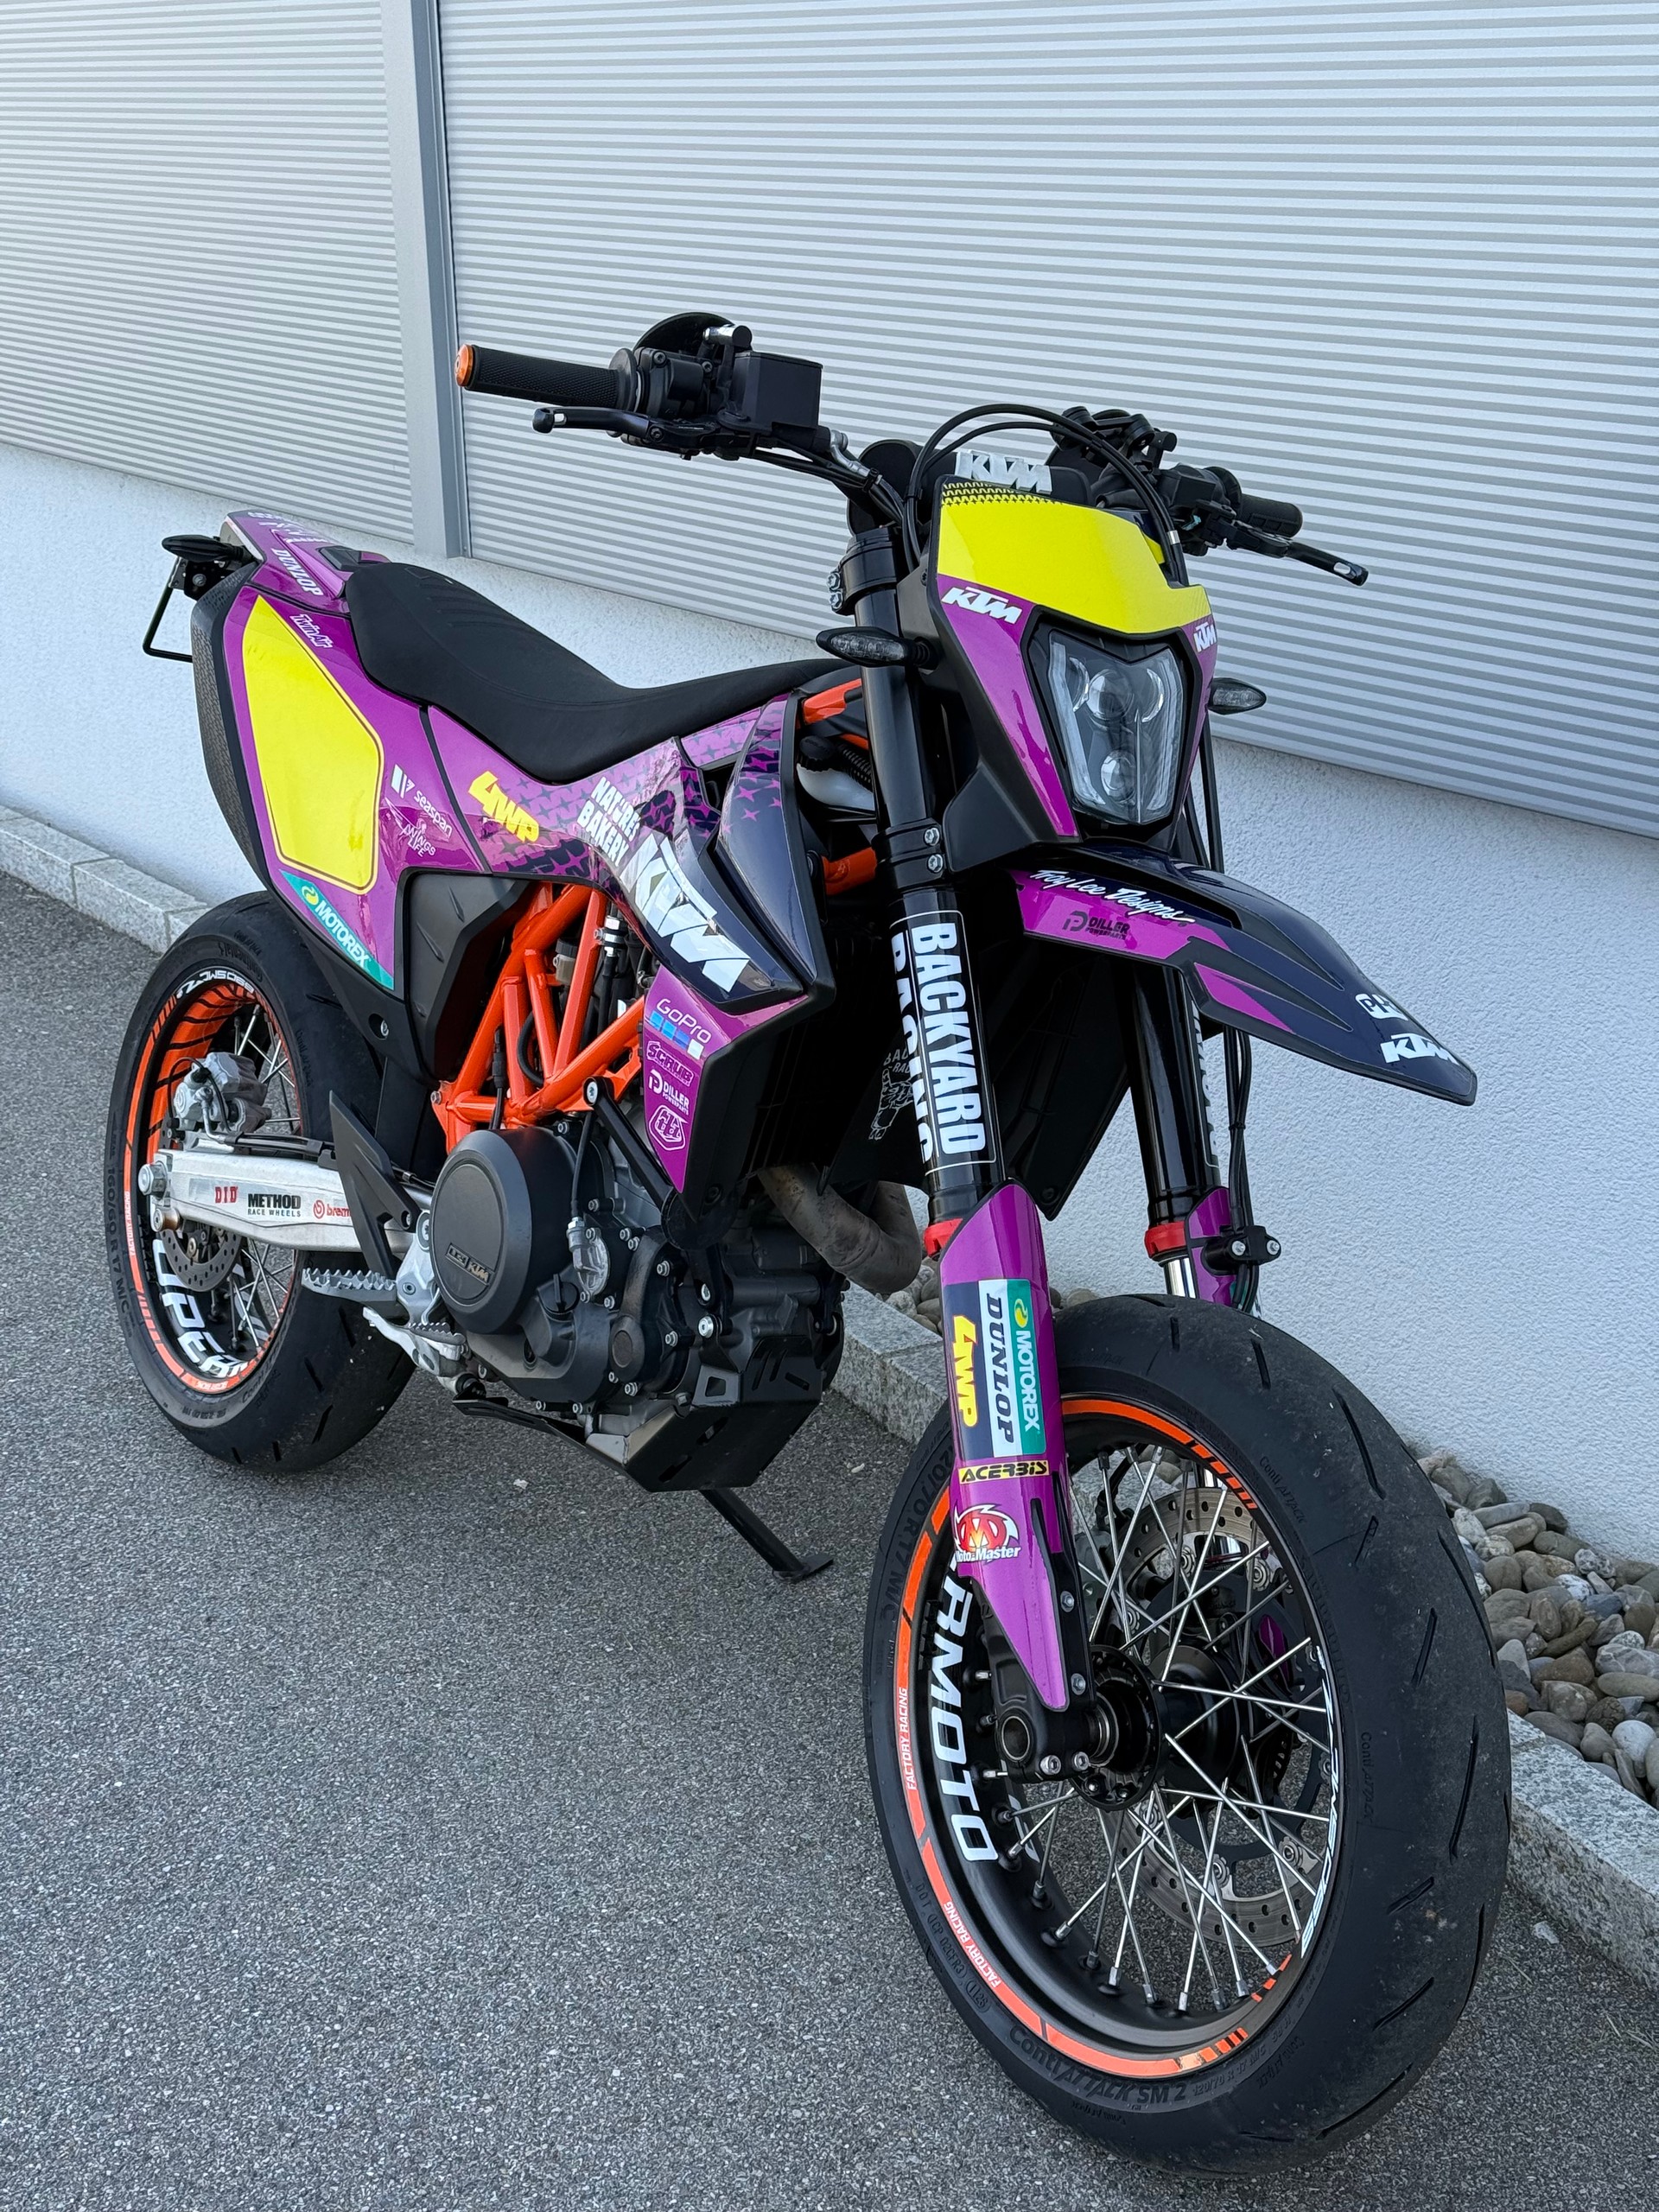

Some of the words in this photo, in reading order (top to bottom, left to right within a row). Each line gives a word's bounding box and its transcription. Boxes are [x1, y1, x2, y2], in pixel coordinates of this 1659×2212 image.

[955, 451, 1052, 495] KTM
[271, 548, 324, 596] DUNLOP
[941, 586, 1023, 625] KTM
[1193, 621, 1217, 653] KTM
[414, 791, 453, 839] seaspan
[576, 797, 629, 867] BAKERY
[620, 832, 751, 993] KTM
[1030, 868, 1076, 890] Troy
[1065, 878, 1106, 895] Lee
[1104, 887, 1196, 923] Designs
[315, 900, 371, 969] MOTOREX
[1088, 917, 1130, 935] DILLER
[656, 998, 712, 1044] GoPro
[911, 922, 987, 1155] BACKYARD
[647, 1043, 693, 1083] SCRUB
[1380, 1033, 1460, 1066] KTM
[663, 1080, 690, 1109] DILLER
[247, 1193, 302, 1210] METHOD
[326, 1204, 352, 1217] brem
[467, 1262, 490, 1283] KTM
[986, 1293, 1015, 1444] DUNLOP
[1016, 1330, 1040, 1433] MOTOREX
[913, 1449, 953, 1514] 20/70
[898, 1687, 908, 1732] RACING
[930, 1552, 999, 1861] RMOTO
[899, 1731, 917, 1790] FACTORY
[944, 1900, 969, 1942] RACING
[963, 1939, 1002, 1989] FACTORY
[1137, 2087, 1167, 2104] SM
[1174, 2085, 1186, 2101] 2
